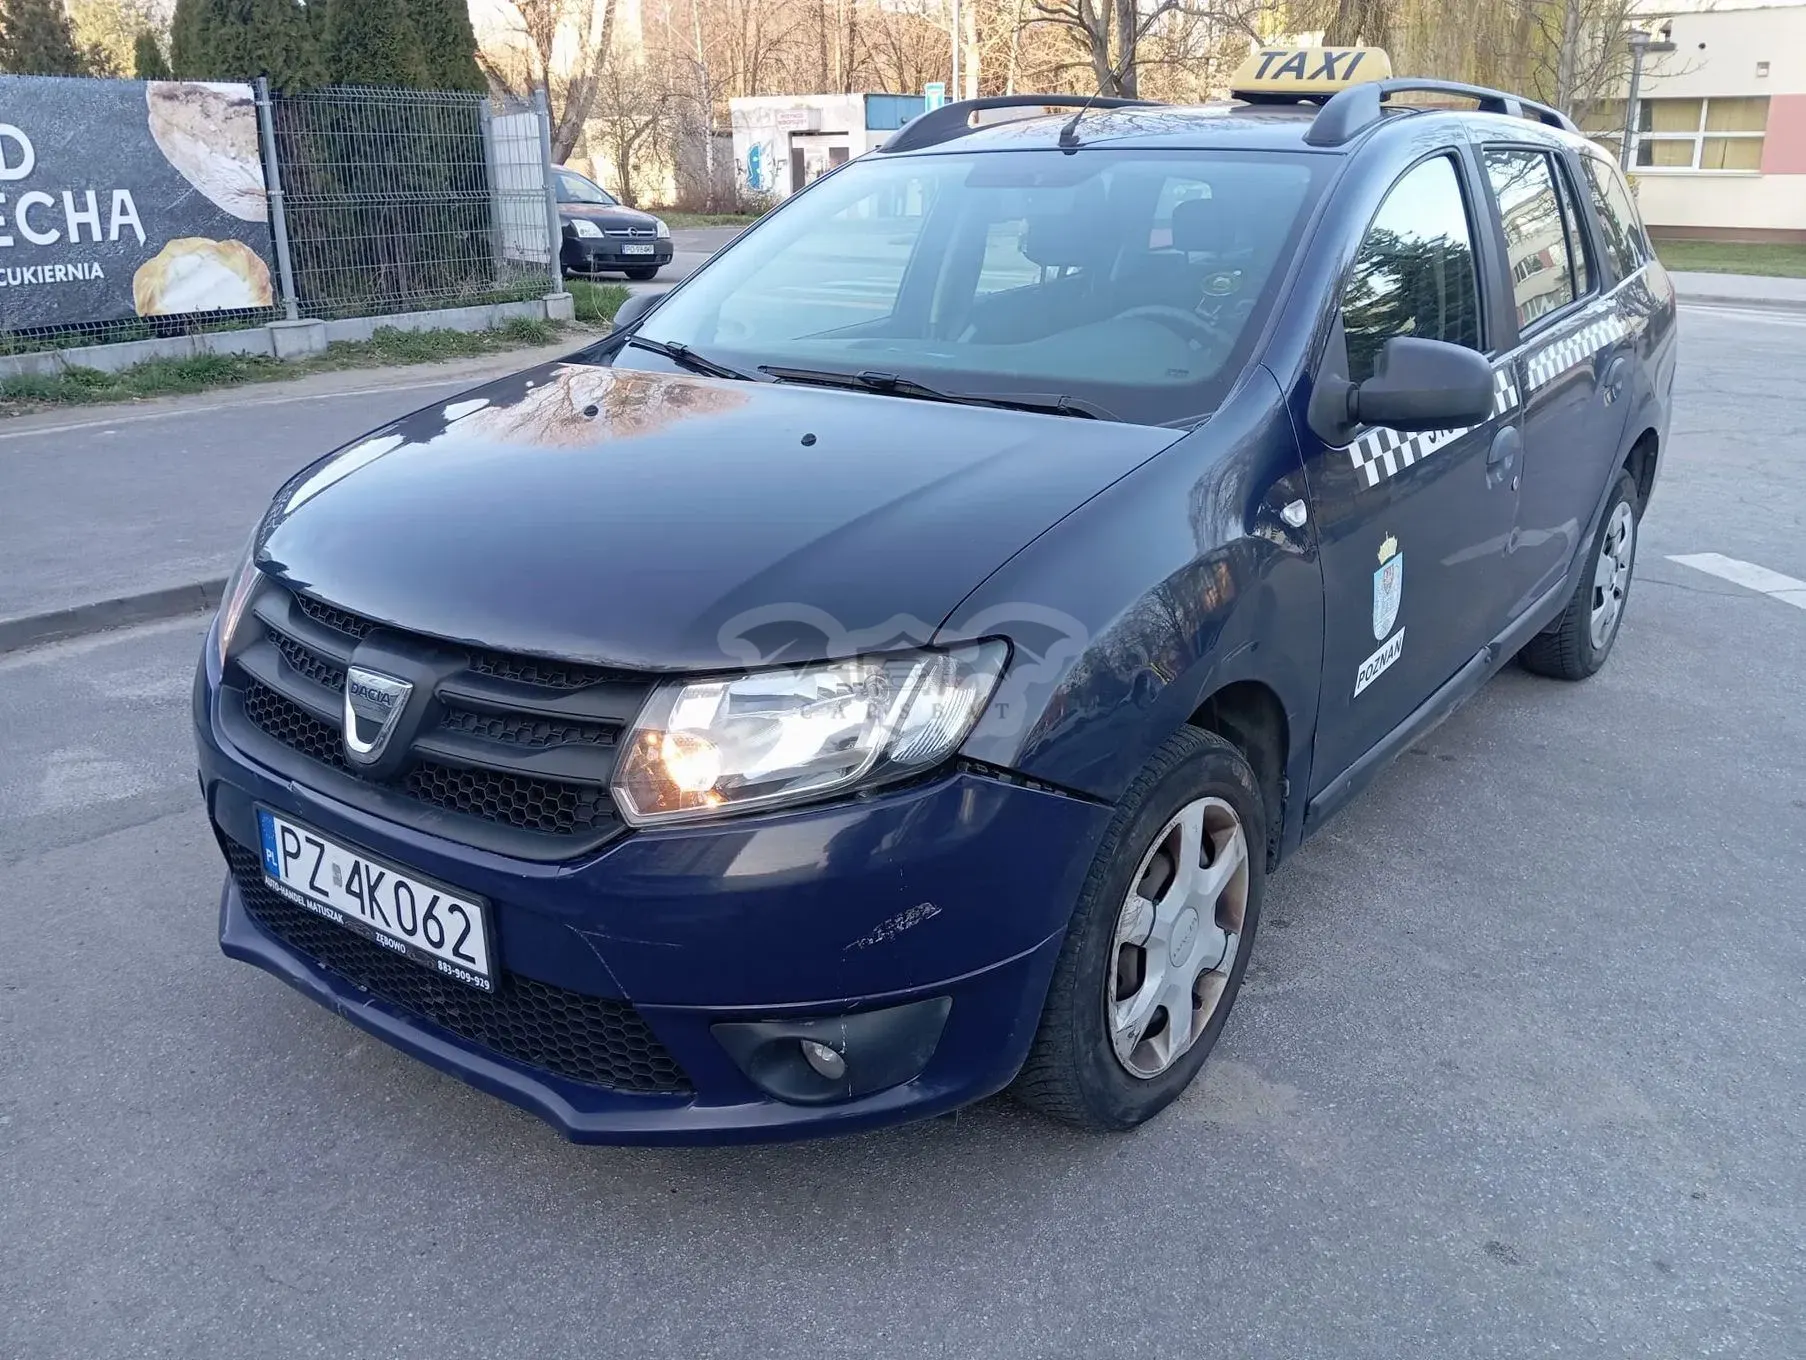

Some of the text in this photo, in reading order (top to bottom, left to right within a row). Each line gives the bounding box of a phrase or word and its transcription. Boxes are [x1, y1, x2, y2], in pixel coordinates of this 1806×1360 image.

[1254, 51, 1367, 81] TAXI
[351, 683, 392, 707] DACIA
[265, 848, 278, 868] PL
[264, 875, 345, 925] AUTO-HANDEL MATUSZAK
[280, 824, 477, 965] PZ 4K062
[375, 931, 406, 954] ZĘBOWO
[437, 960, 491, 990] 883-909-929
